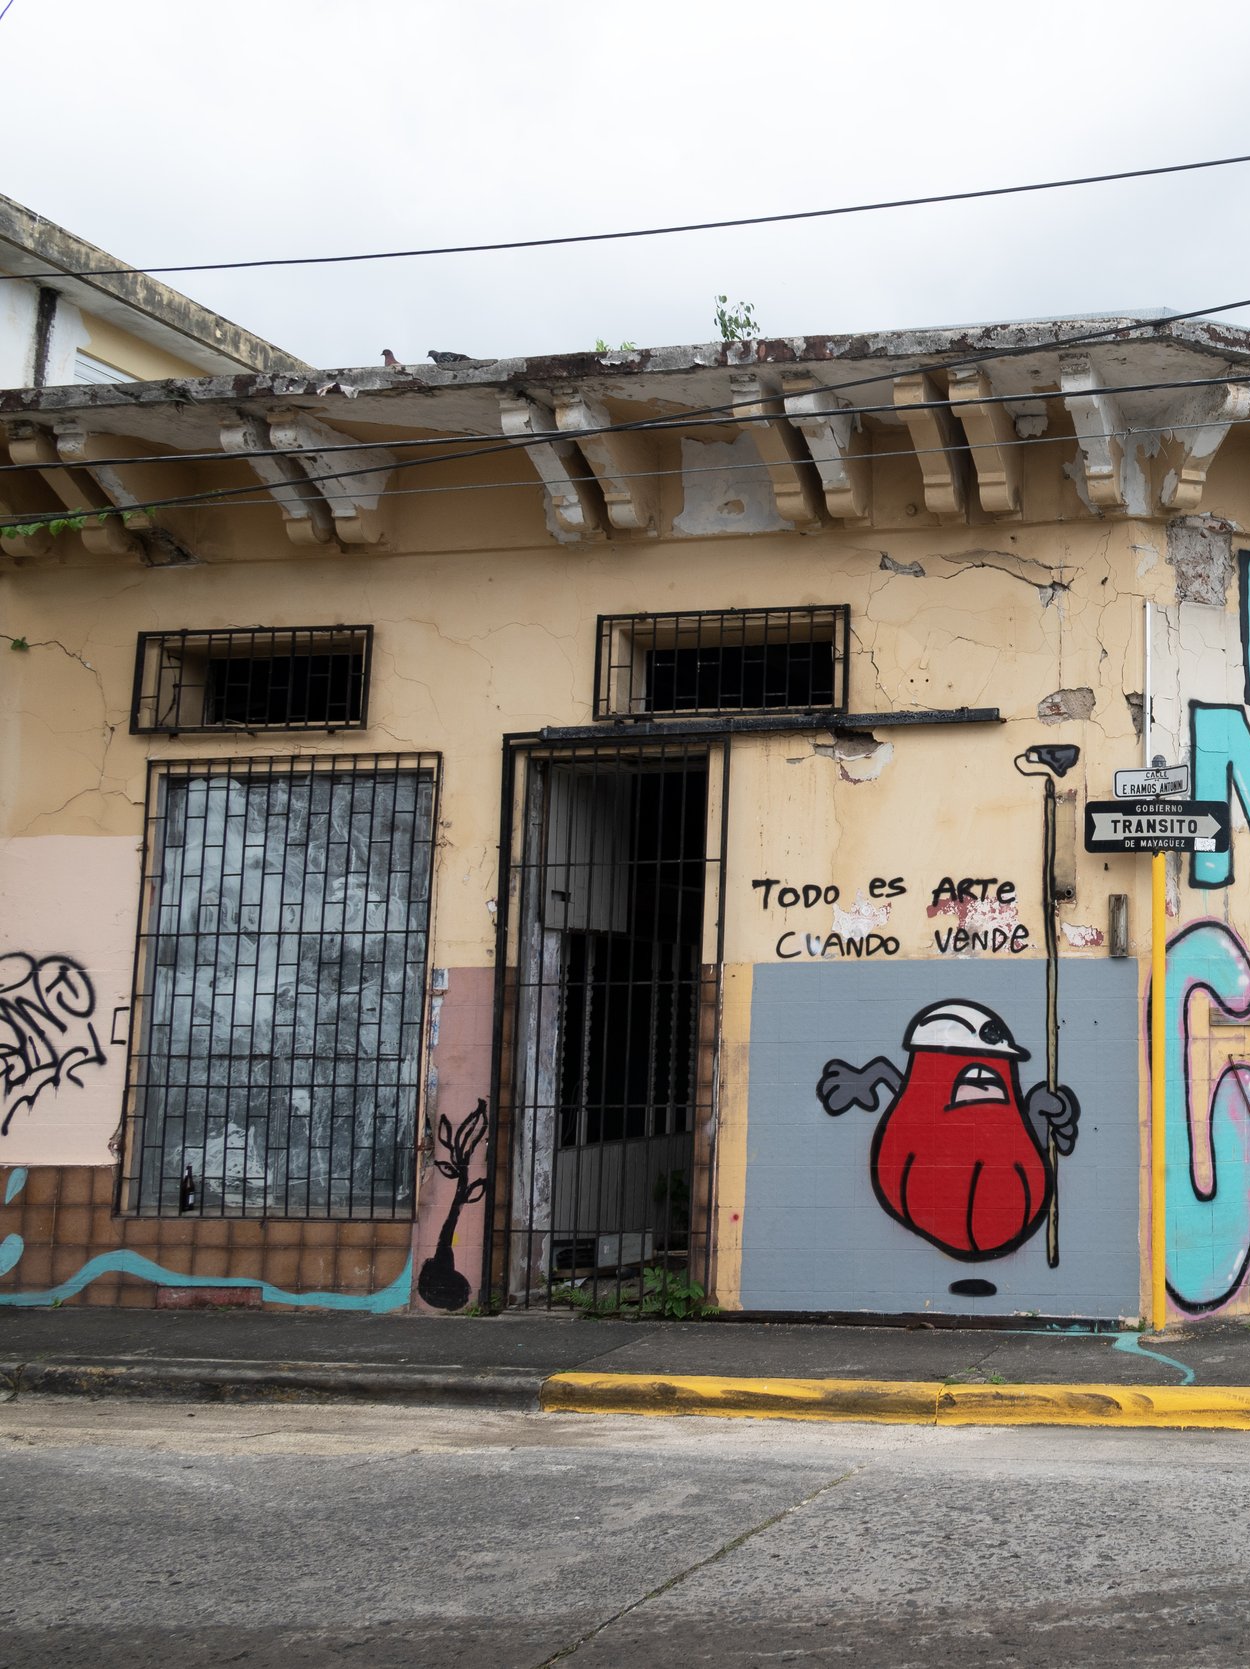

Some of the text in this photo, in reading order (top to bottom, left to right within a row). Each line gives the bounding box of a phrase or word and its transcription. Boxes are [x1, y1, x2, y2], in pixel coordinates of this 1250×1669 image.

[1145, 770, 1168, 778] CALLE
[1135, 804, 1183, 813] GOBIERNO
[1111, 818, 1198, 834] TRANSITO
[1124, 838, 1185, 848] DE MAYAGÜEZ
[775, 931, 900, 959] CUANDO
